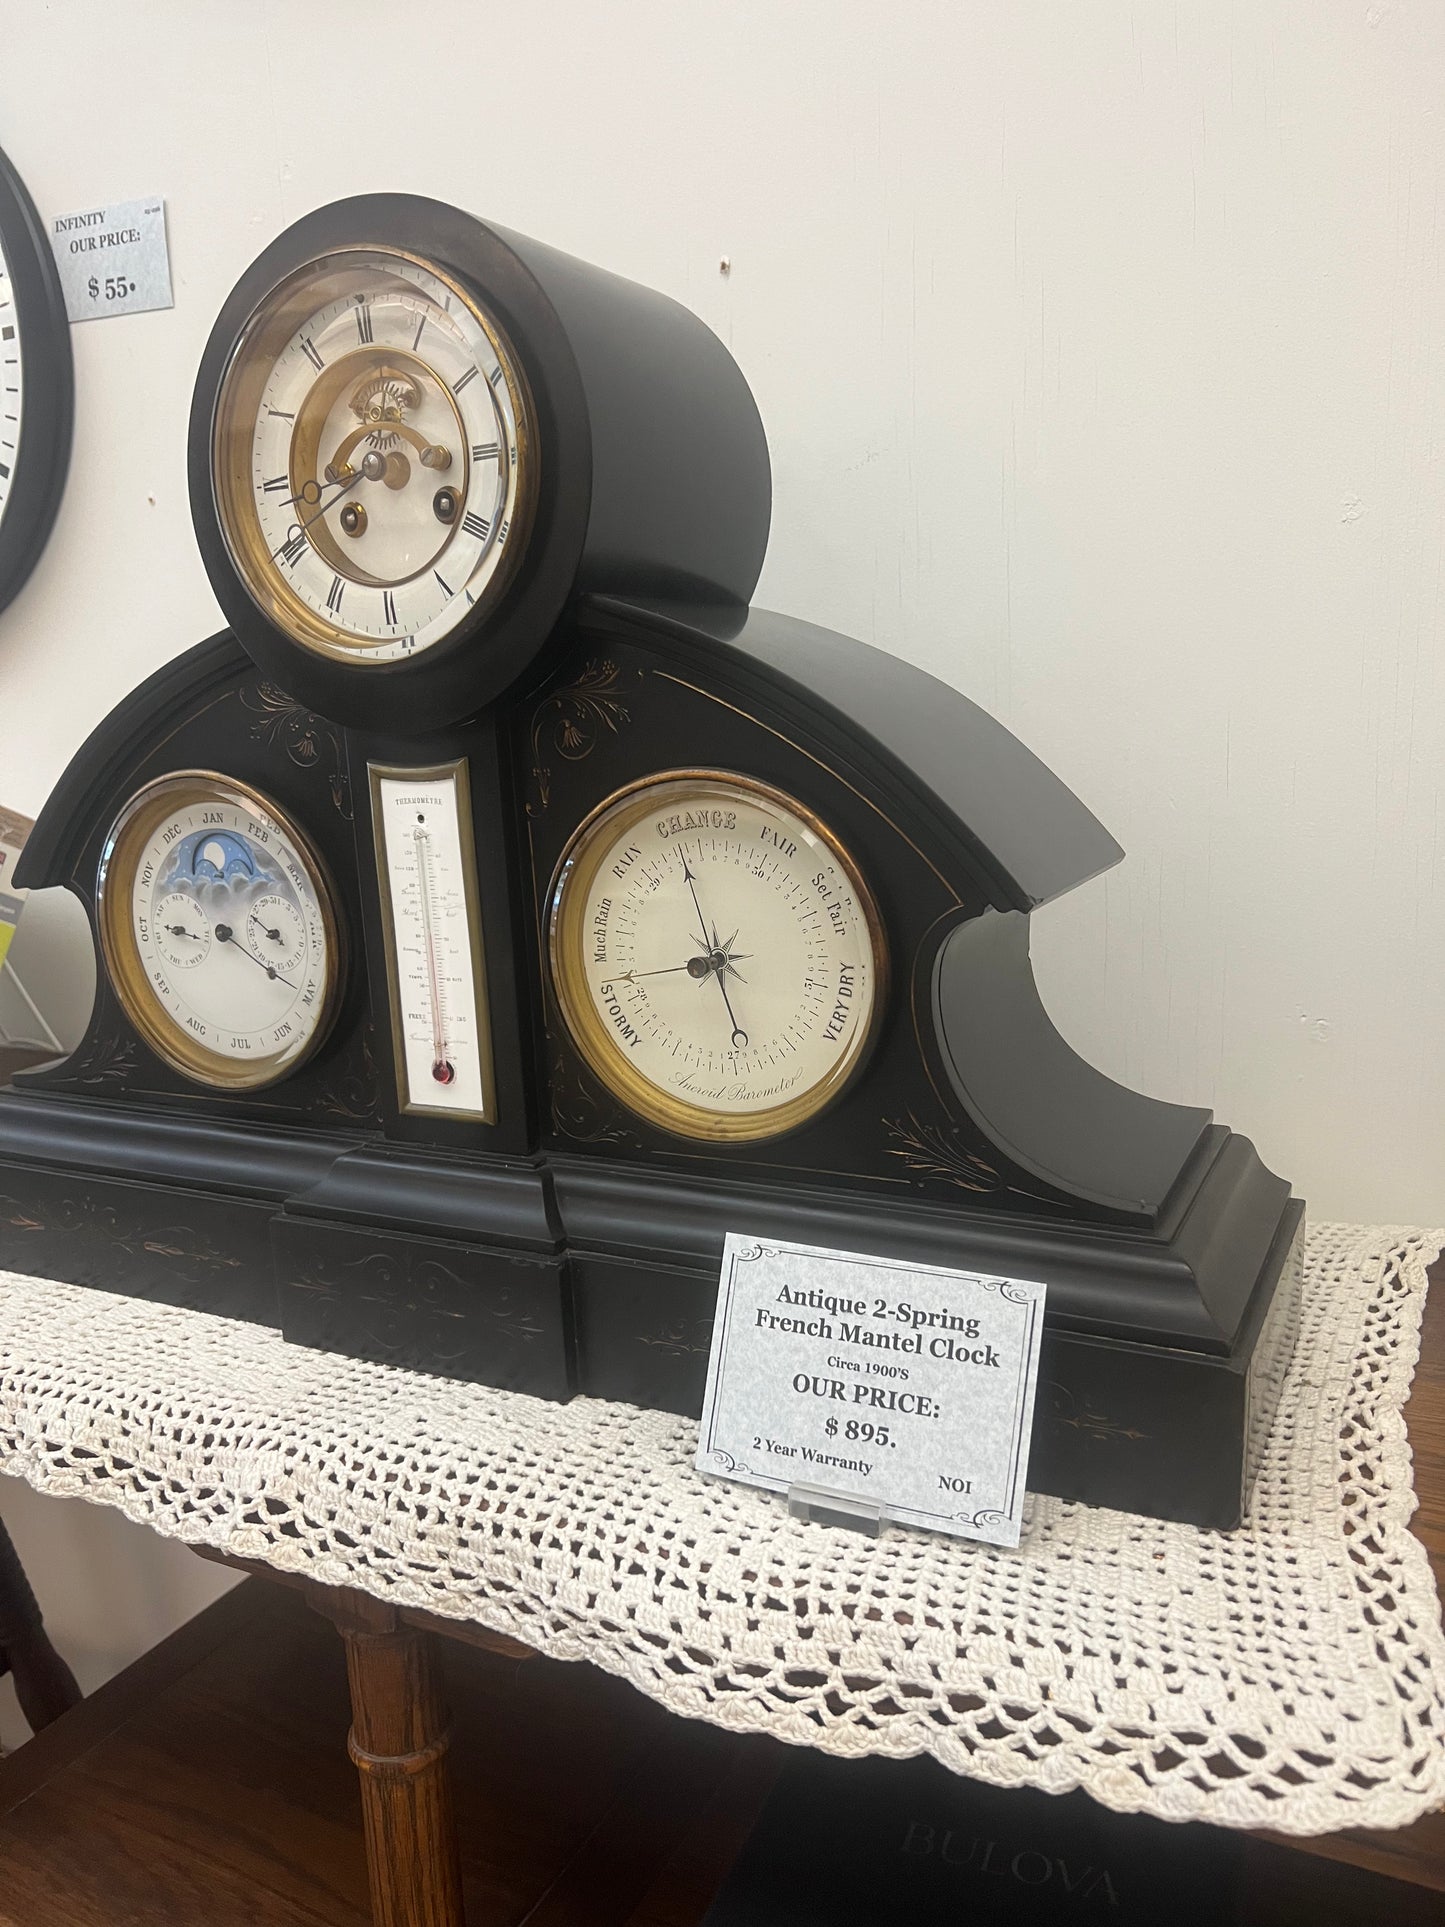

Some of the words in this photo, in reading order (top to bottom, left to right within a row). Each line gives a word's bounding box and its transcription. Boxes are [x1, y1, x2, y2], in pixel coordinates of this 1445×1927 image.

[55, 210, 106, 233] INFINITY
[70, 237, 97, 254] OUR
[99, 229, 141, 249] PRICE:
[88, 275, 100, 302] $
[203, 812, 224, 824] JAN
[656, 809, 737, 839] CHANGE
[248, 822, 269, 843] FEB
[760, 826, 797, 858] FAIR
[141, 861, 155, 888] NOV
[612, 843, 642, 879] RAIN
[594, 898, 612, 927] Rain
[811, 873, 833, 901] Set
[826, 902, 847, 936] Fair
[139, 916, 149, 942] OCT
[593, 928, 607, 964] Much
[153, 972, 170, 995] SEP
[302, 979, 317, 1007] MAY
[823, 998, 850, 1041] VERY
[838, 961, 855, 998] DRY
[186, 1017, 207, 1036] AUG
[601, 984, 642, 1048] STORMY
[230, 1038, 251, 1049] JUL
[273, 1021, 293, 1042] JUN
[727, 1050, 740, 1060] 27
[728, 1066, 804, 1100] Barometer
[776, 1284, 867, 1316] Antique
[872, 1299, 981, 1338] 2-Spring
[755, 1308, 833, 1339] French
[838, 1322, 922, 1354] Mantel
[929, 1338, 1001, 1368] Clock
[827, 1355, 861, 1372] Circa
[865, 1363, 910, 1380] 1900'S
[792, 1373, 847, 1402] OUR
[852, 1384, 941, 1419] PRICE:
[825, 1416, 839, 1439] $
[845, 1420, 897, 1448] 895.
[753, 1436, 761, 1450] 2
[765, 1438, 798, 1458] Year
[801, 1447, 874, 1477] Warranty
[939, 1475, 973, 1495] NOI
[902, 1820, 1120, 1905] BULOVA
